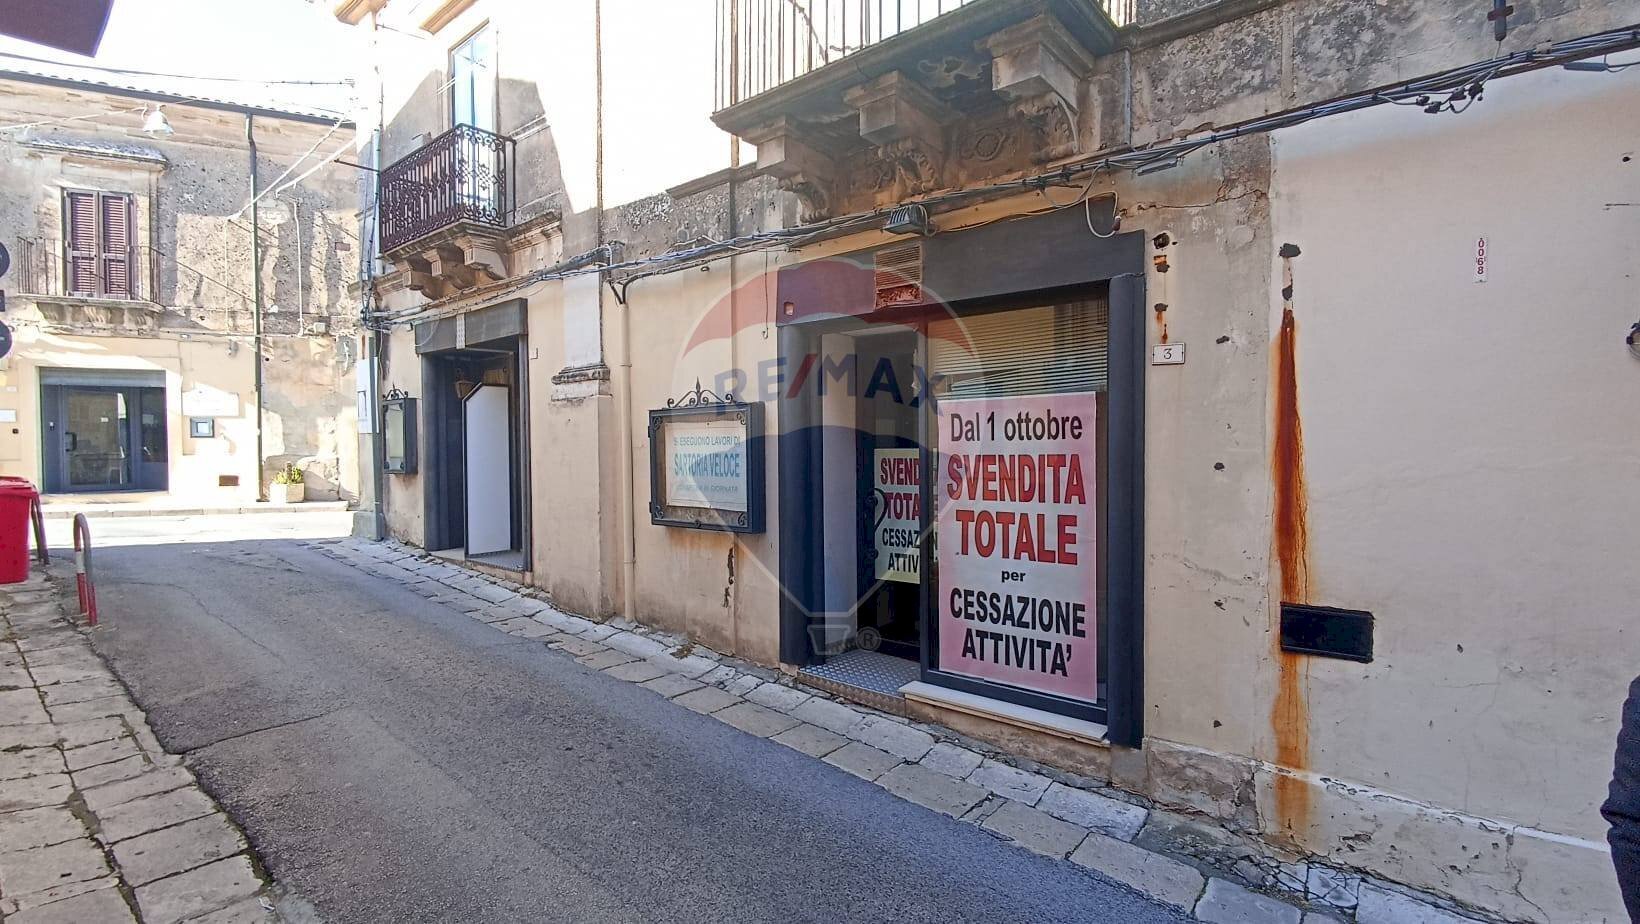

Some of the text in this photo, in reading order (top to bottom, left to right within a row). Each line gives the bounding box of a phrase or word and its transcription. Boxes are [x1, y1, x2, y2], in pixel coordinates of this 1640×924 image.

[1477, 239, 1485, 275] 0068
[1163, 348, 1172, 360] 3
[711, 436, 732, 446] LAVORI
[950, 408, 1083, 442] Dal 1 ottobre
[674, 453, 741, 478] SARTORIA VELOCE
[946, 453, 1087, 505] SVENDITA
[955, 509, 1078, 566] TOTALE
[1001, 570, 1026, 583] per
[950, 587, 1086, 638] CESSAZIONE
[961, 627, 1072, 678] ATTIVITA'
